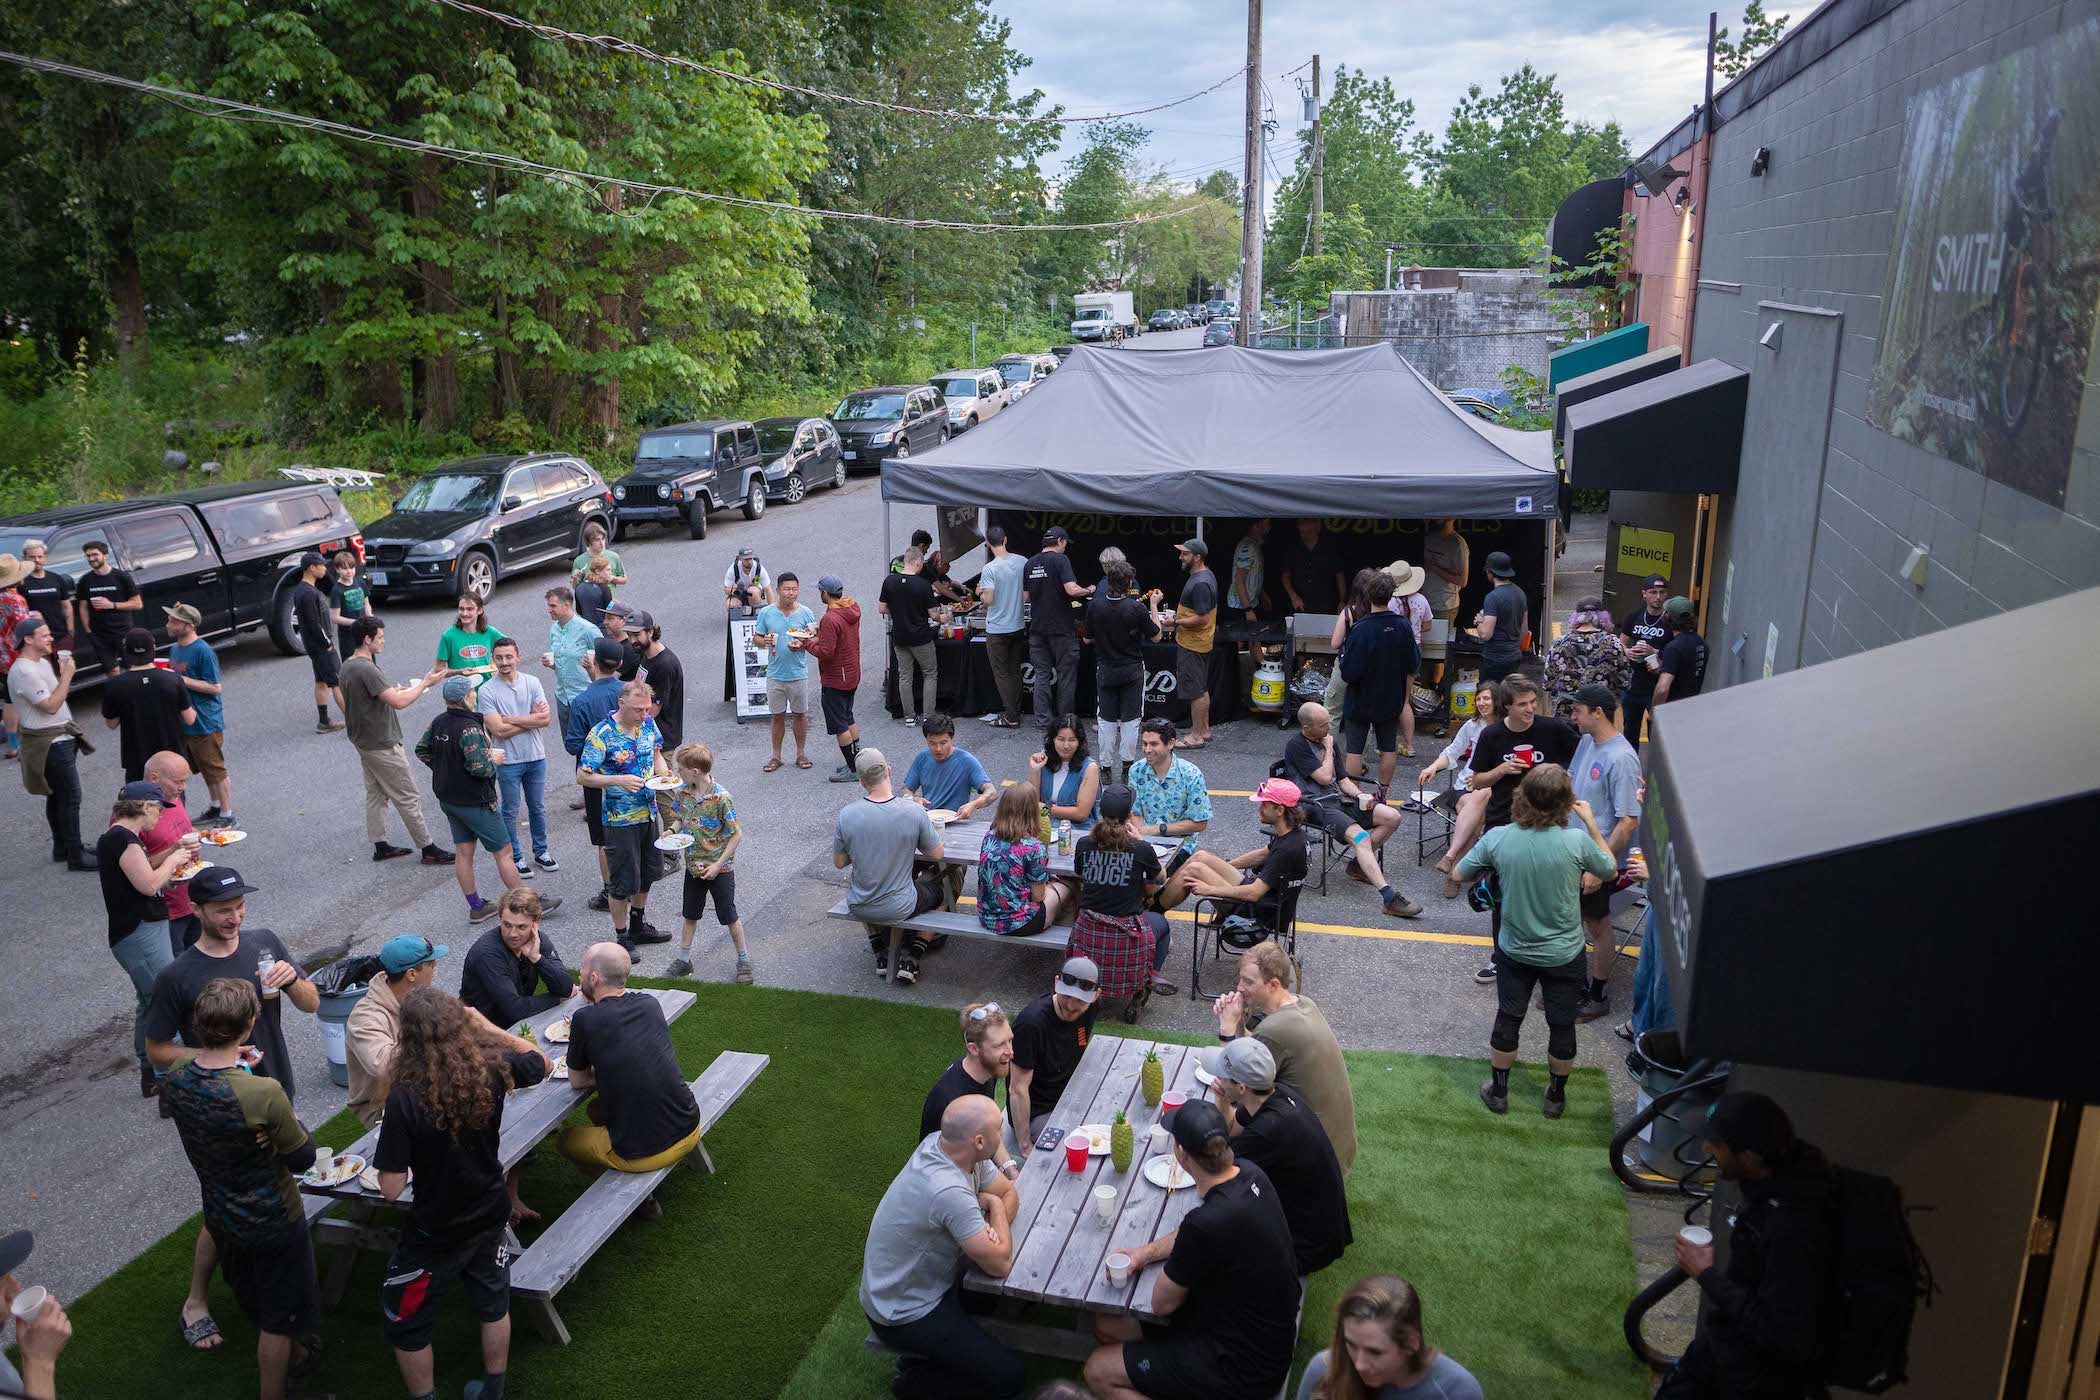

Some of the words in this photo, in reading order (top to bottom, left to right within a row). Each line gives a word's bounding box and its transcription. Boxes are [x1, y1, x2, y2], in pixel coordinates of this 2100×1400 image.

[1932, 232, 2006, 293] SMITH
[1621, 545, 1670, 562] SERVICE
[1082, 850, 1135, 868] LANTERN
[1082, 865, 1132, 887] ROUGE
